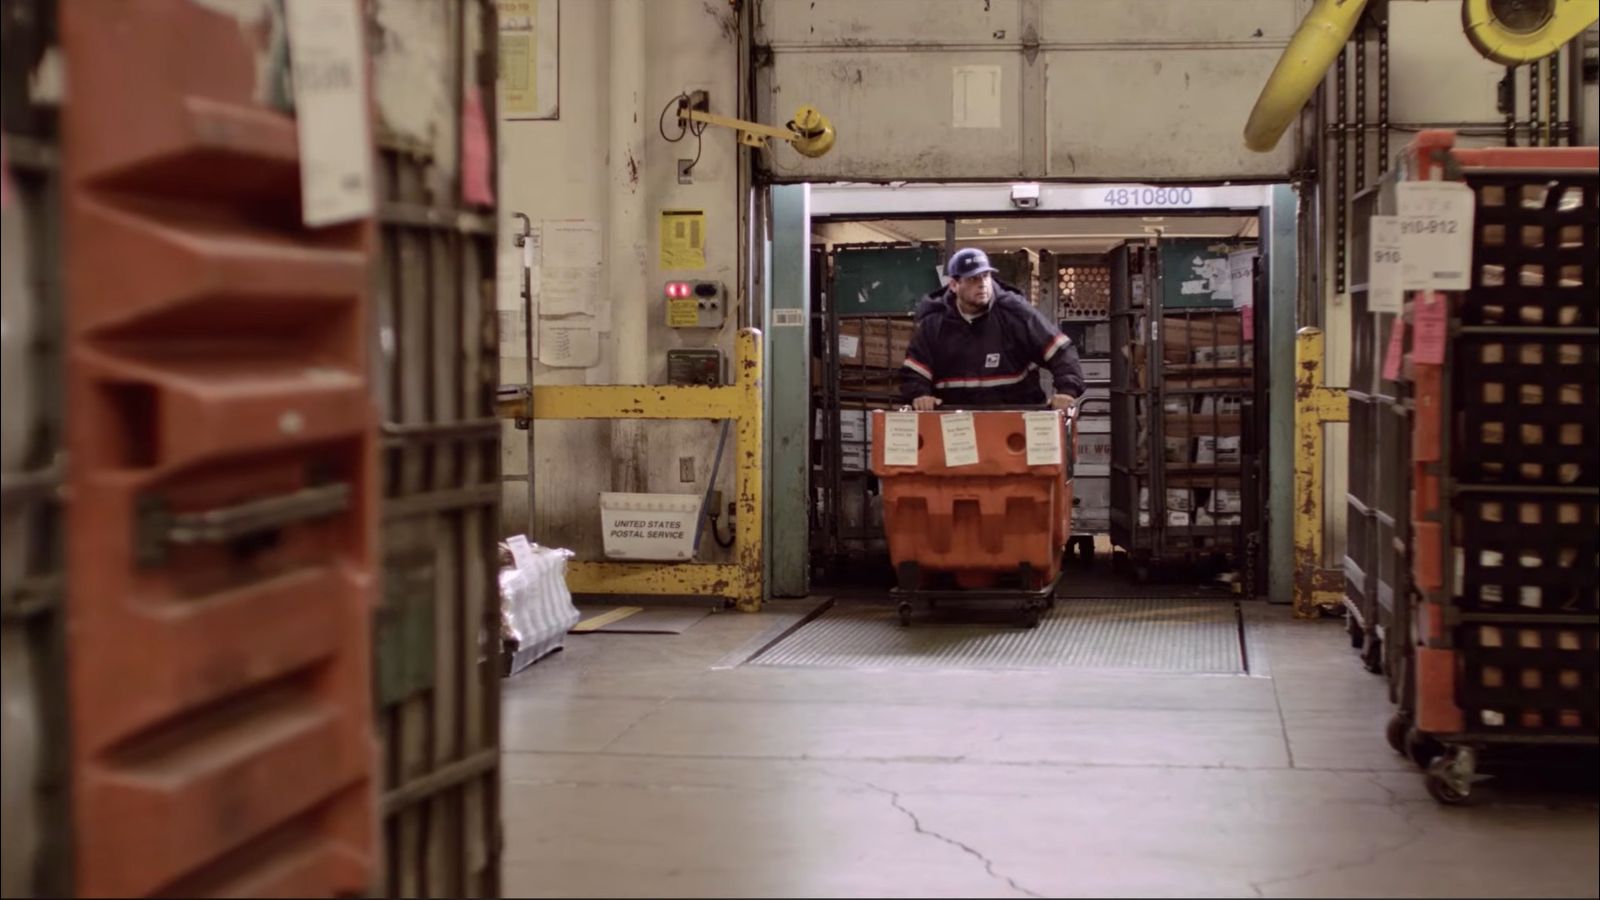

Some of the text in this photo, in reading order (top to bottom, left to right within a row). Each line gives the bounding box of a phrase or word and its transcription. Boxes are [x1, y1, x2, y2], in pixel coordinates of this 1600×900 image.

[1104, 187, 1193, 206] 4810800
[1401, 219, 1458, 234] 910-912
[614, 520, 681, 529] UNITED STATES
[610, 530, 683, 539] POSTAL SERVICE
